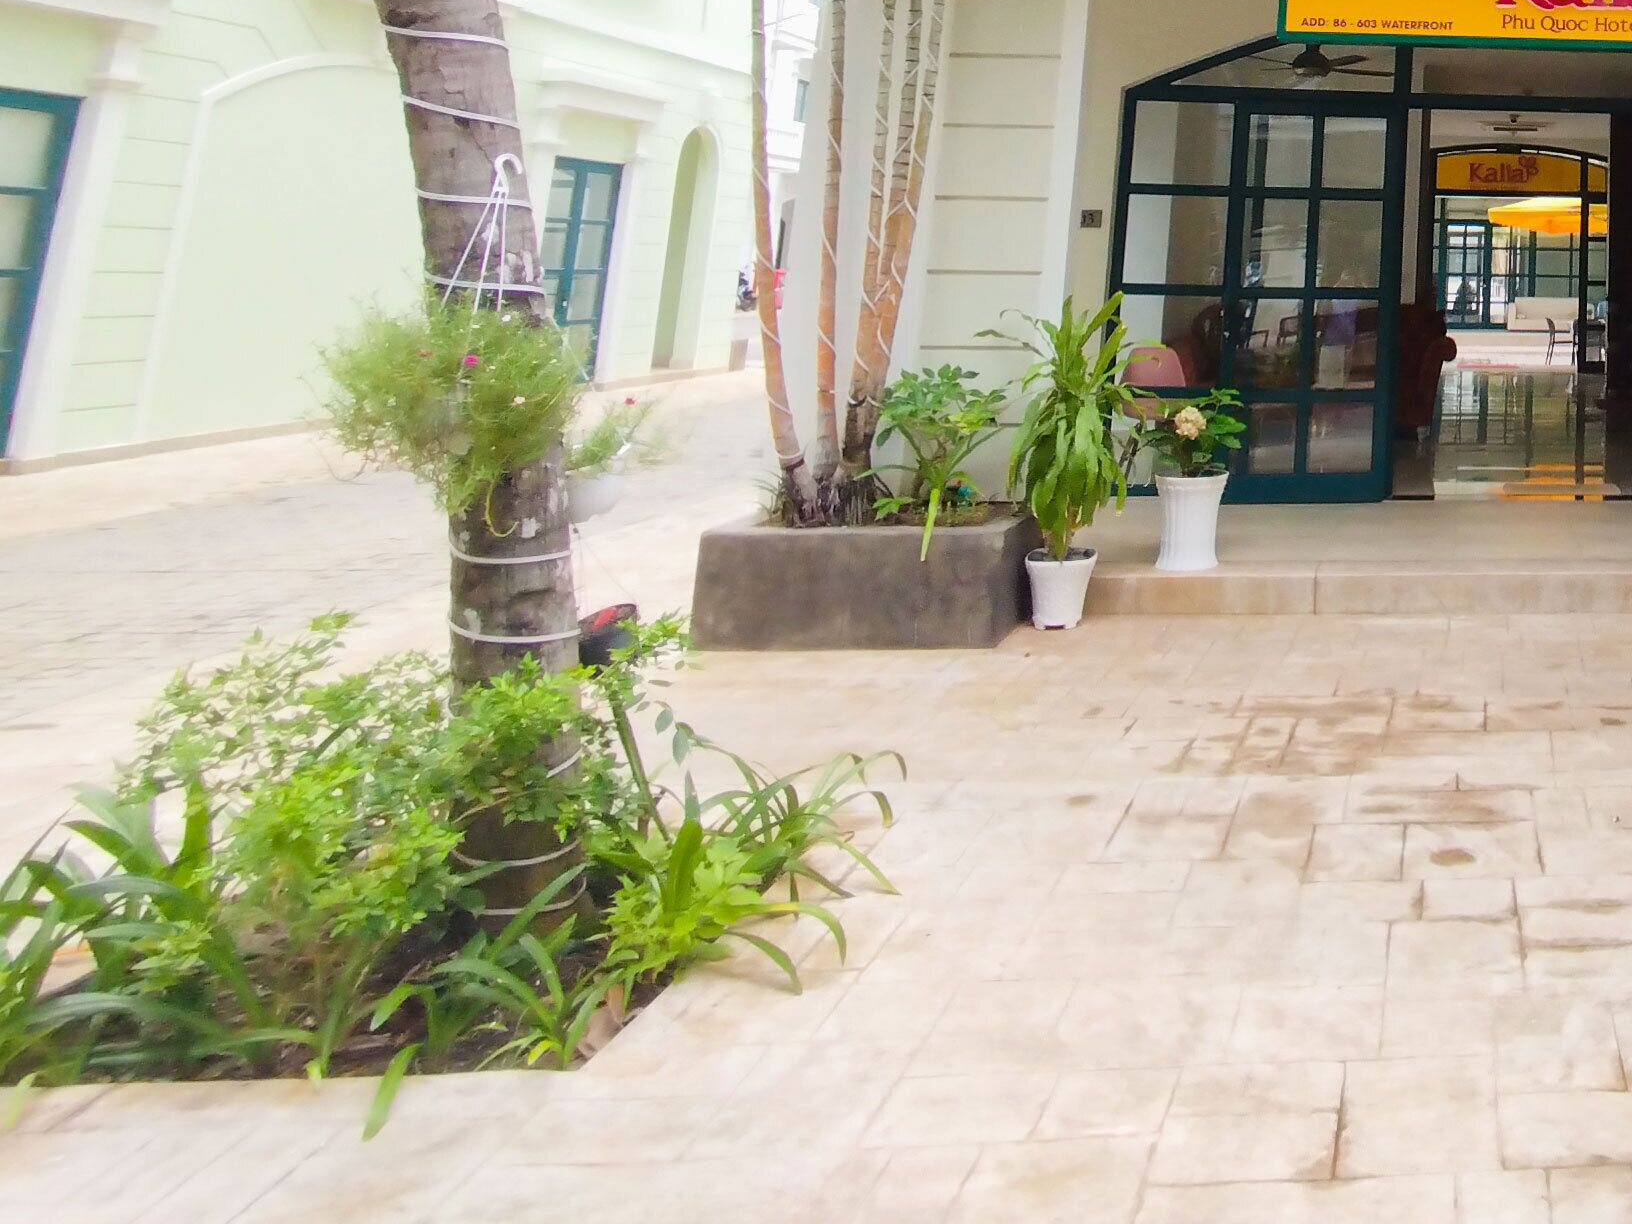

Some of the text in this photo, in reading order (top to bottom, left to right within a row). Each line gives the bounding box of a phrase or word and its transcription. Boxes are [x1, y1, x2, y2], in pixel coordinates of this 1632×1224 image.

[1333, 19, 1347, 28] 86
[1356, 19, 1377, 29] 603
[1381, 20, 1454, 31] WATERFRONT
[1502, 13, 1535, 30] Phu
[1540, 15, 1589, 33] Quoc
